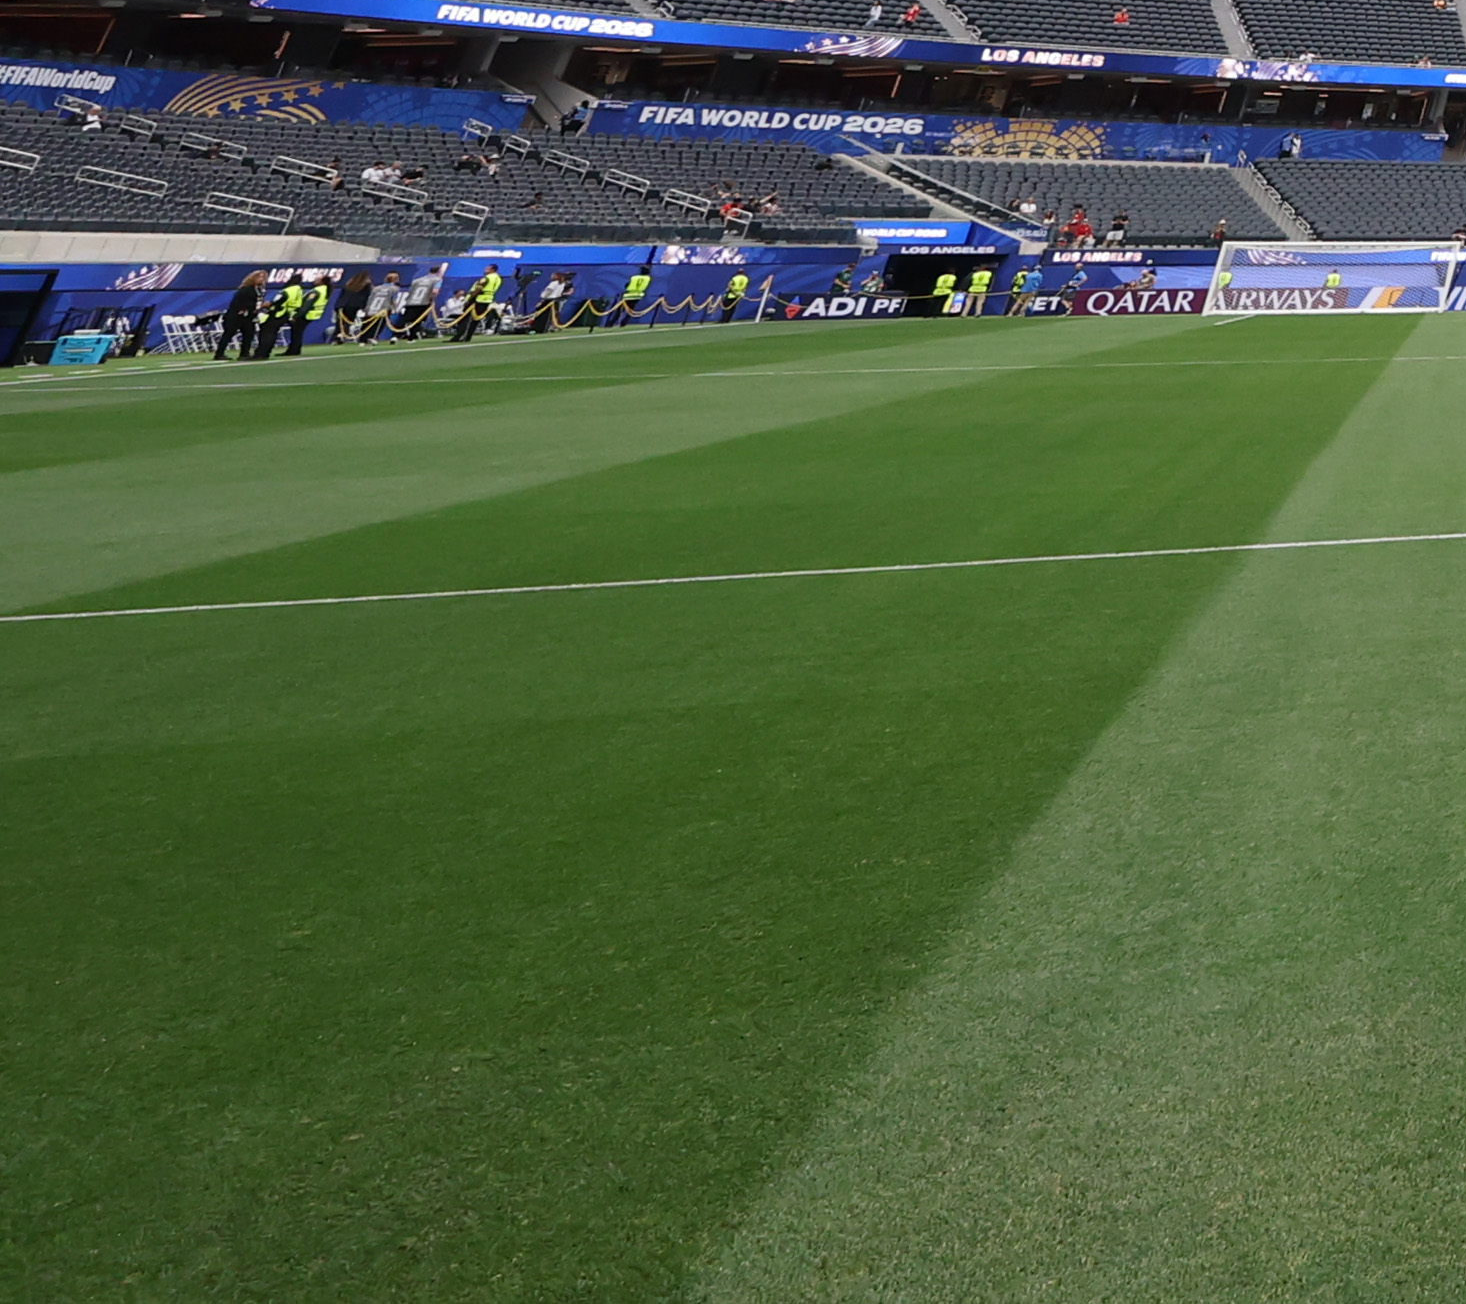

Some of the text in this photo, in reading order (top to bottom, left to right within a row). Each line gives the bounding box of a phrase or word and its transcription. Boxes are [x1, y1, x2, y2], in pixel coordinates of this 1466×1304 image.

[436, 4, 481, 23] FIFA
[482, 8, 553, 29] WORLD
[550, 14, 591, 32] CUP
[981, 48, 1105, 67] LOS ANGELES
[638, 106, 925, 135] FIFA WORLD CUP 2026
[900, 246, 996, 254] LOS ANGELES
[1052, 251, 1143, 263] LOS ANGELES
[267, 268, 295, 283] LOS
[802, 296, 868, 317] ADI
[1086, 291, 1195, 315] QATAR
[1213, 289, 1336, 311] AIRWAYS
